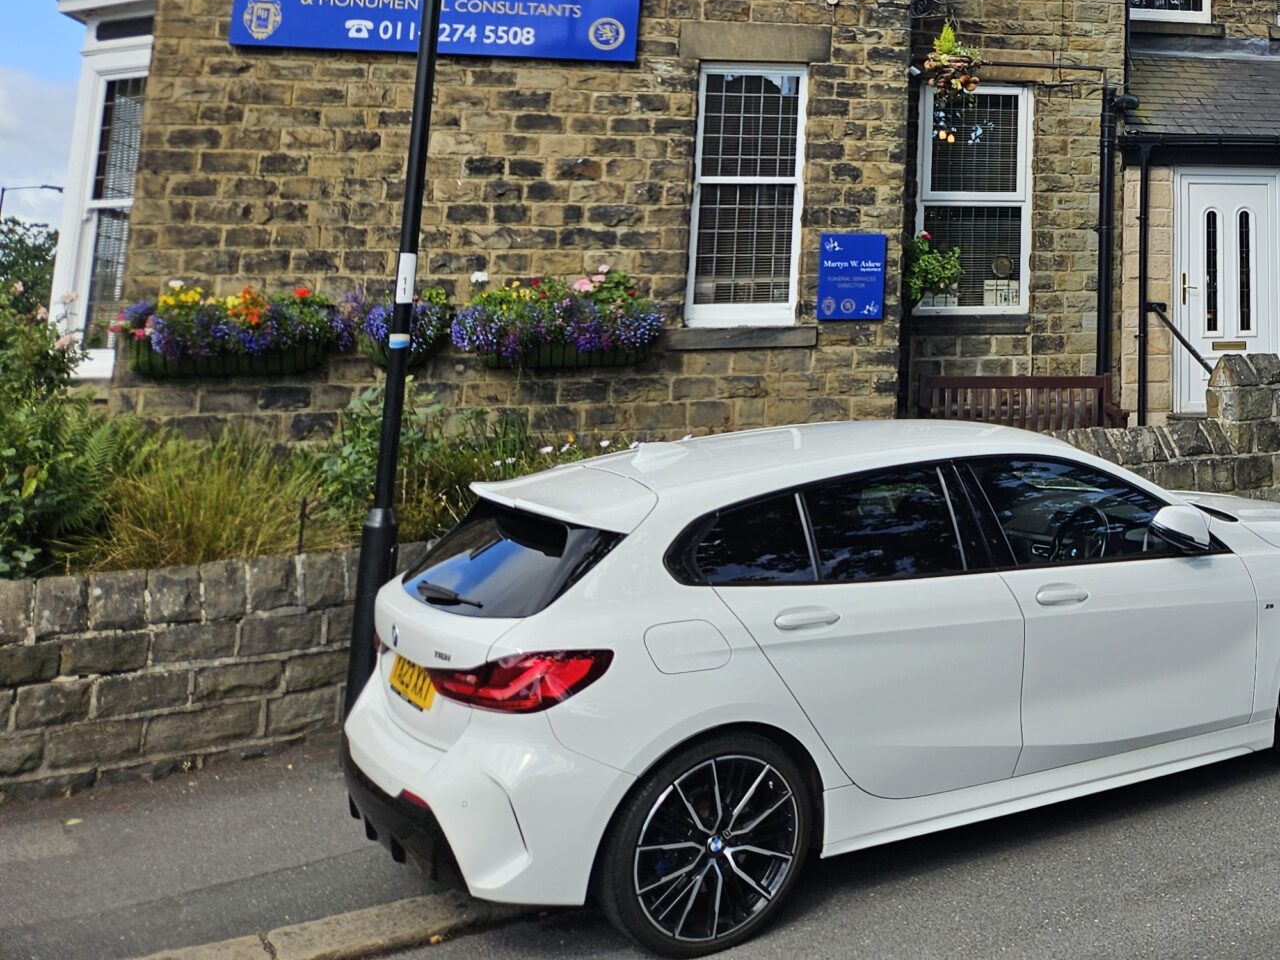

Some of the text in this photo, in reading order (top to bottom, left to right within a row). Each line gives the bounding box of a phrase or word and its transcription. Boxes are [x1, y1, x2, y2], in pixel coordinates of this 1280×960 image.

[454, 0, 582, 18] CONSULTANTS
[379, 20, 535, 45] 011 274 5508
[824, 260, 848, 270] Martyn
